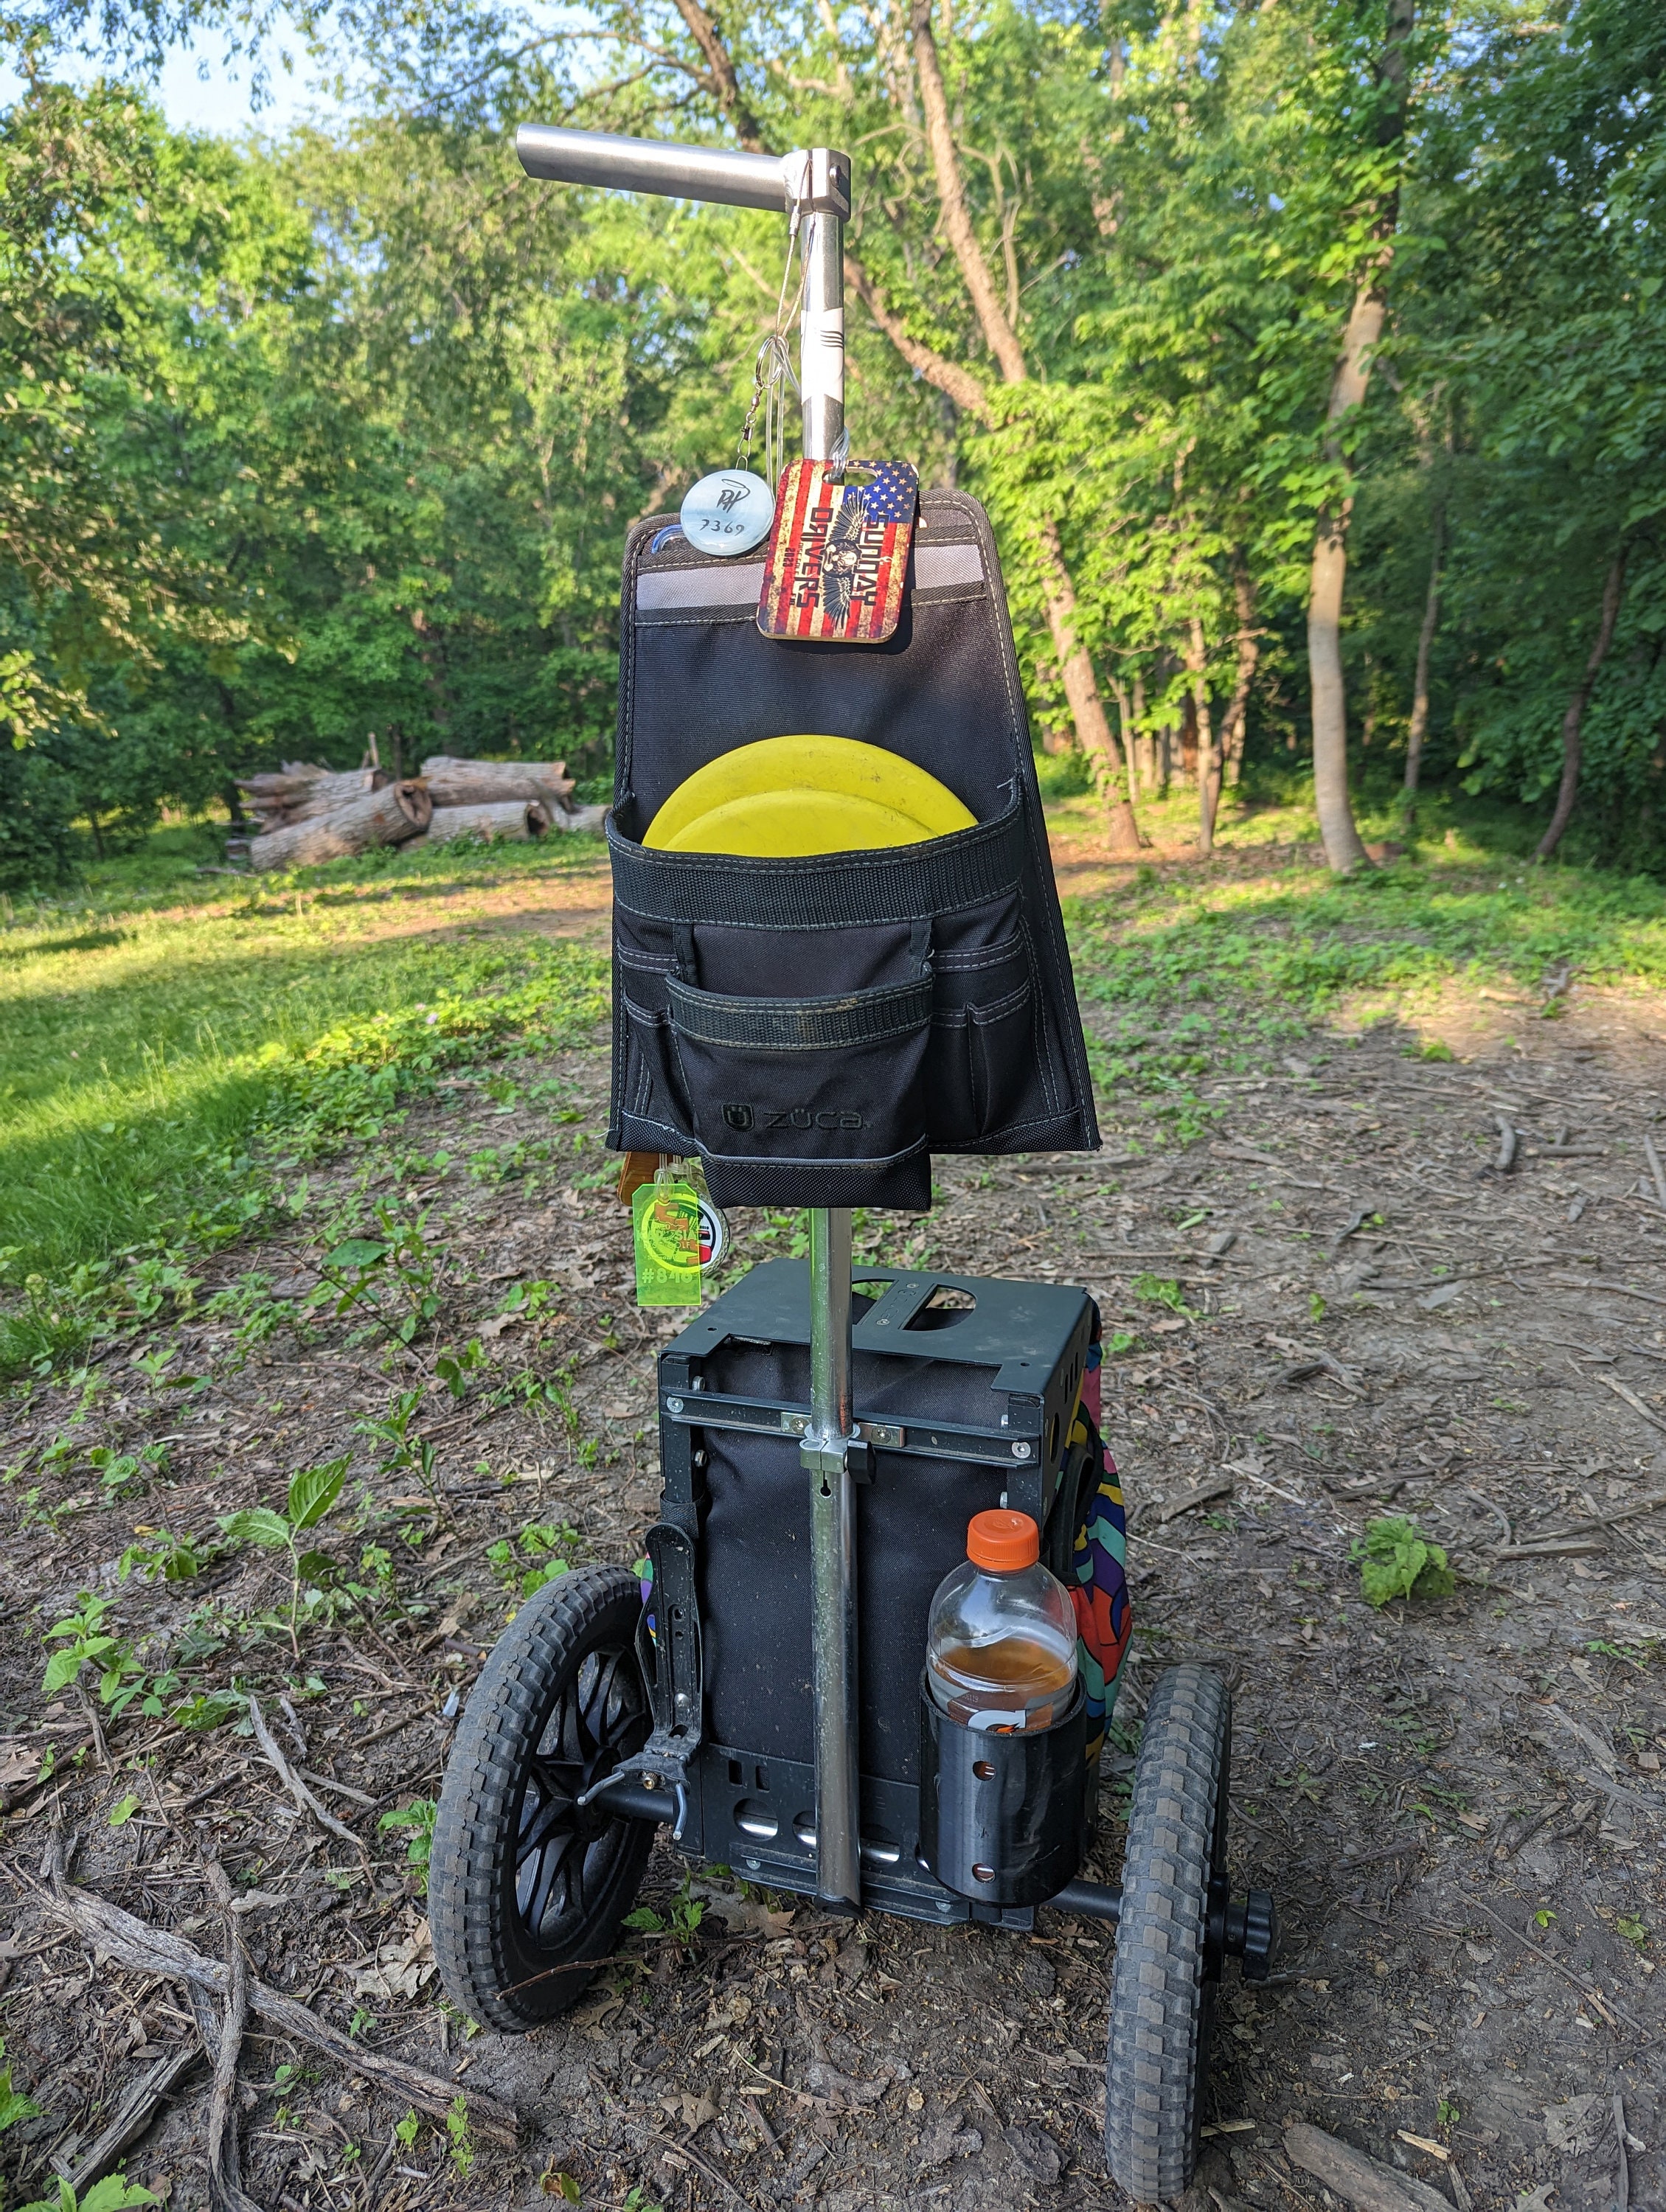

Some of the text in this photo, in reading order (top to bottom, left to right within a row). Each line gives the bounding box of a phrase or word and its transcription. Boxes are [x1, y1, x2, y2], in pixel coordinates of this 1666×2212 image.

[699, 518, 745, 536] 7369
[782, 547, 796, 567] 2023
[794, 507, 834, 608] DRIVERS
[850, 512, 890, 606] SUNDAY
